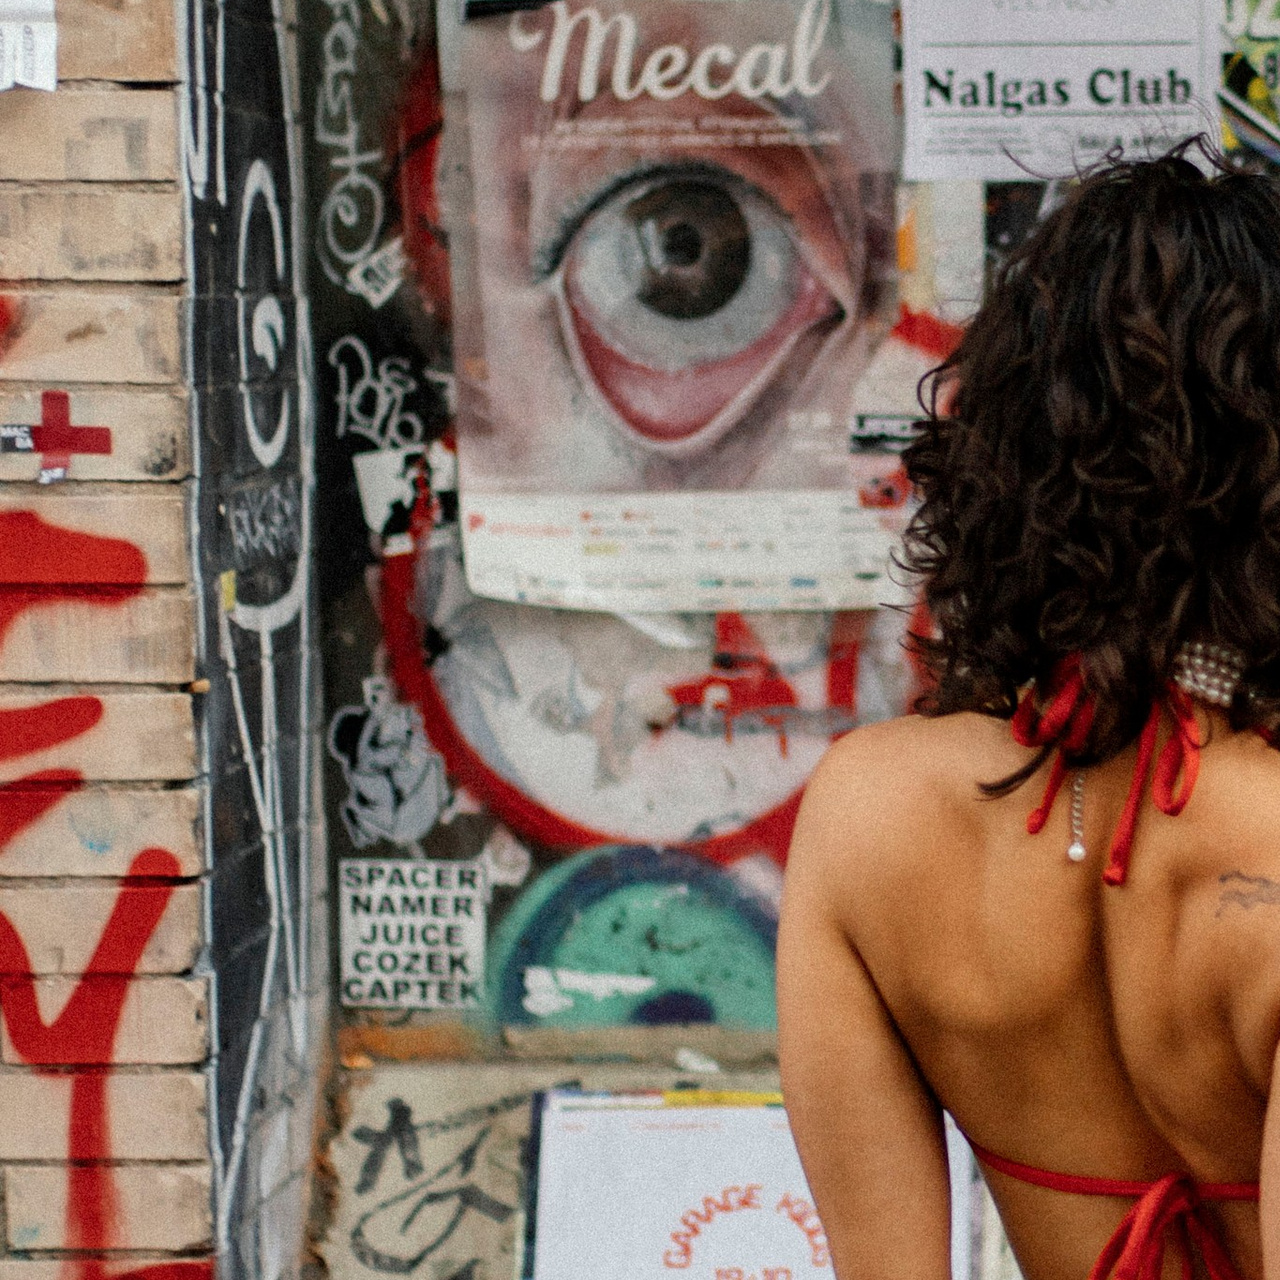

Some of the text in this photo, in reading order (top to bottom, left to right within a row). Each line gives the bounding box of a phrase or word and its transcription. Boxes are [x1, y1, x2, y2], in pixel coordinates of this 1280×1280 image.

[922, 67, 1194, 116] Nalgas Club
[342, 865, 479, 891] SPACER
[350, 893, 473, 918] NAMER
[359, 923, 463, 948] JUICE
